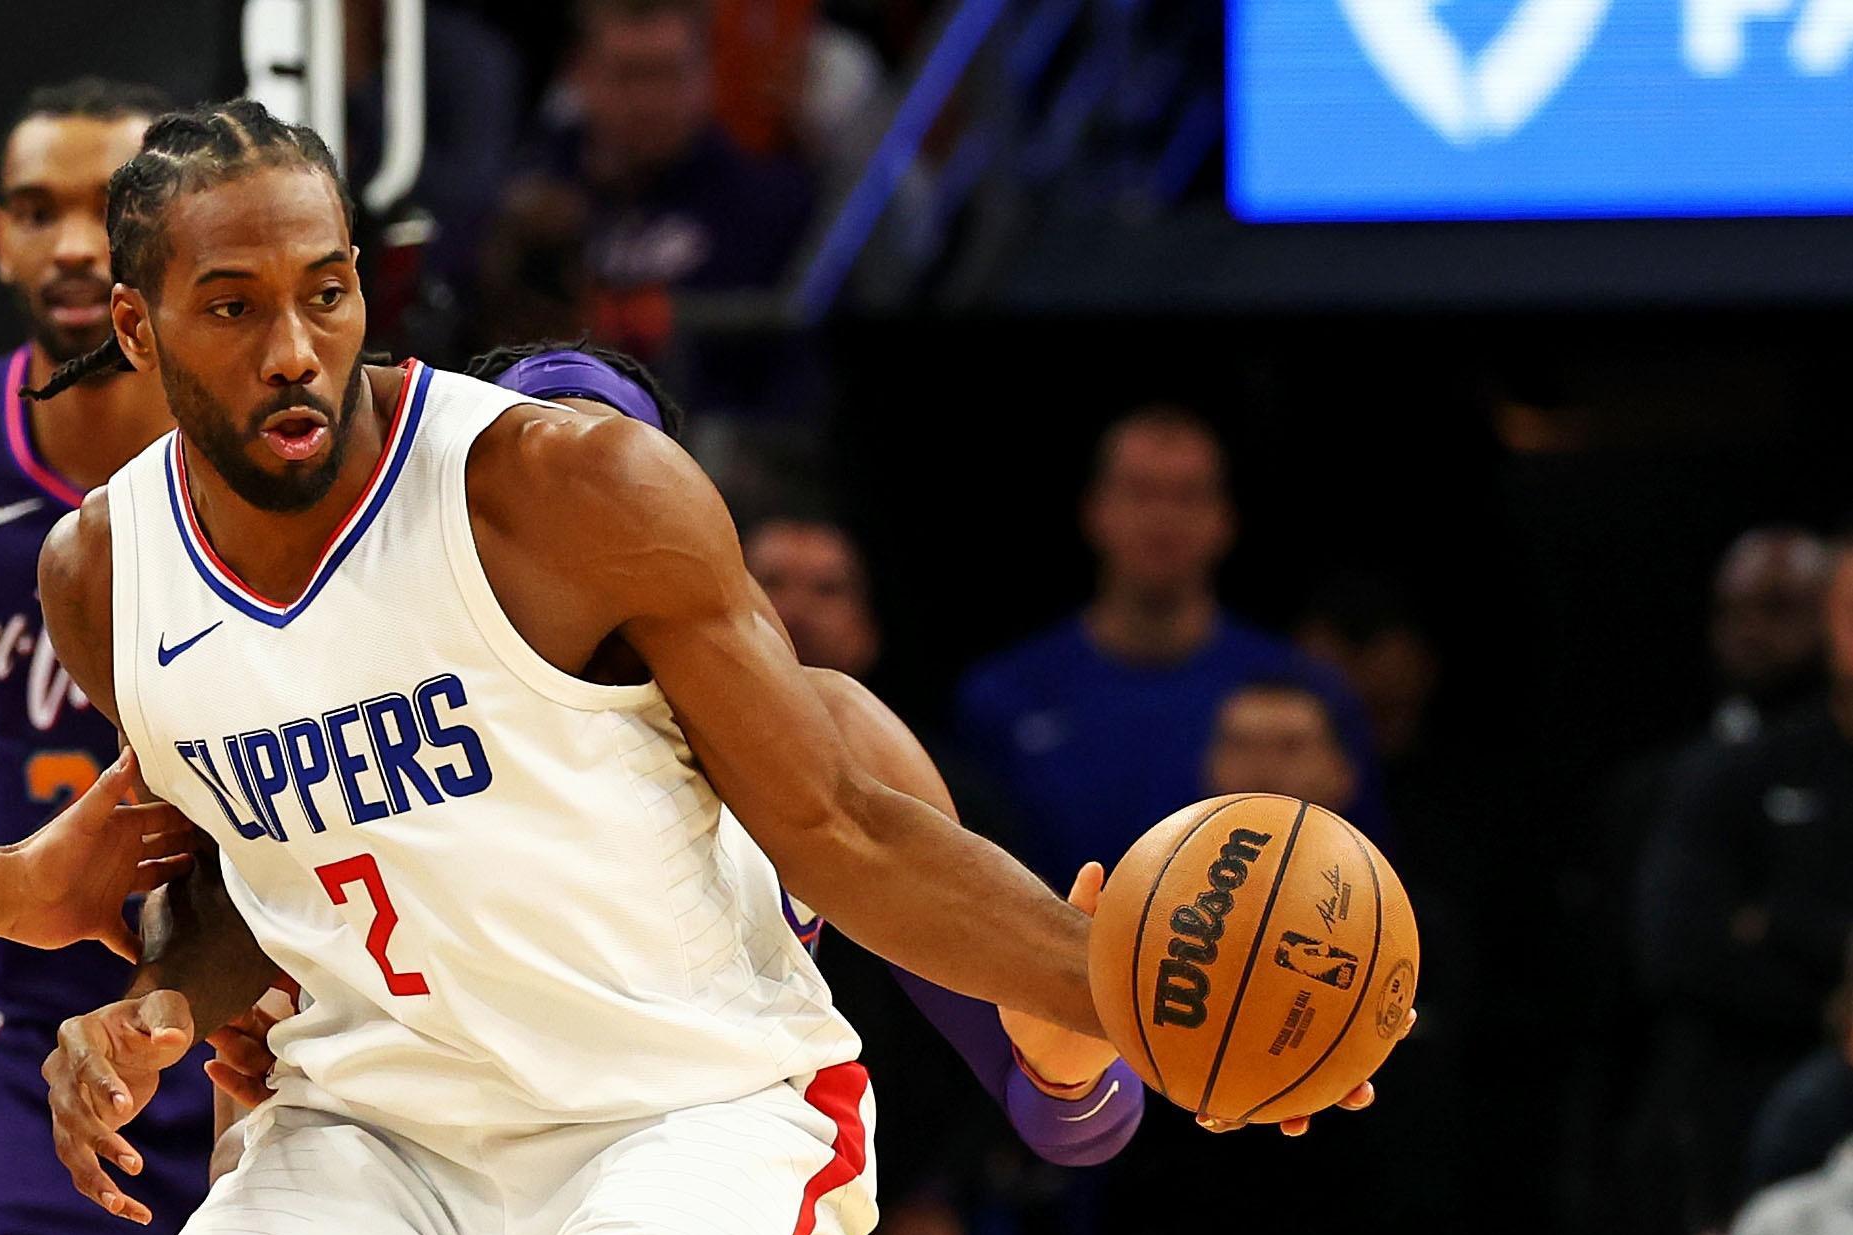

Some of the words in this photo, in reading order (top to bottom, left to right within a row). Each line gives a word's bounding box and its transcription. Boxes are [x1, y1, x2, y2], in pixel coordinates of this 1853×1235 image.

[314, 853, 430, 996] 2
[1153, 828, 1273, 1029] Wilson
[1294, 989, 1312, 1009] BALL
